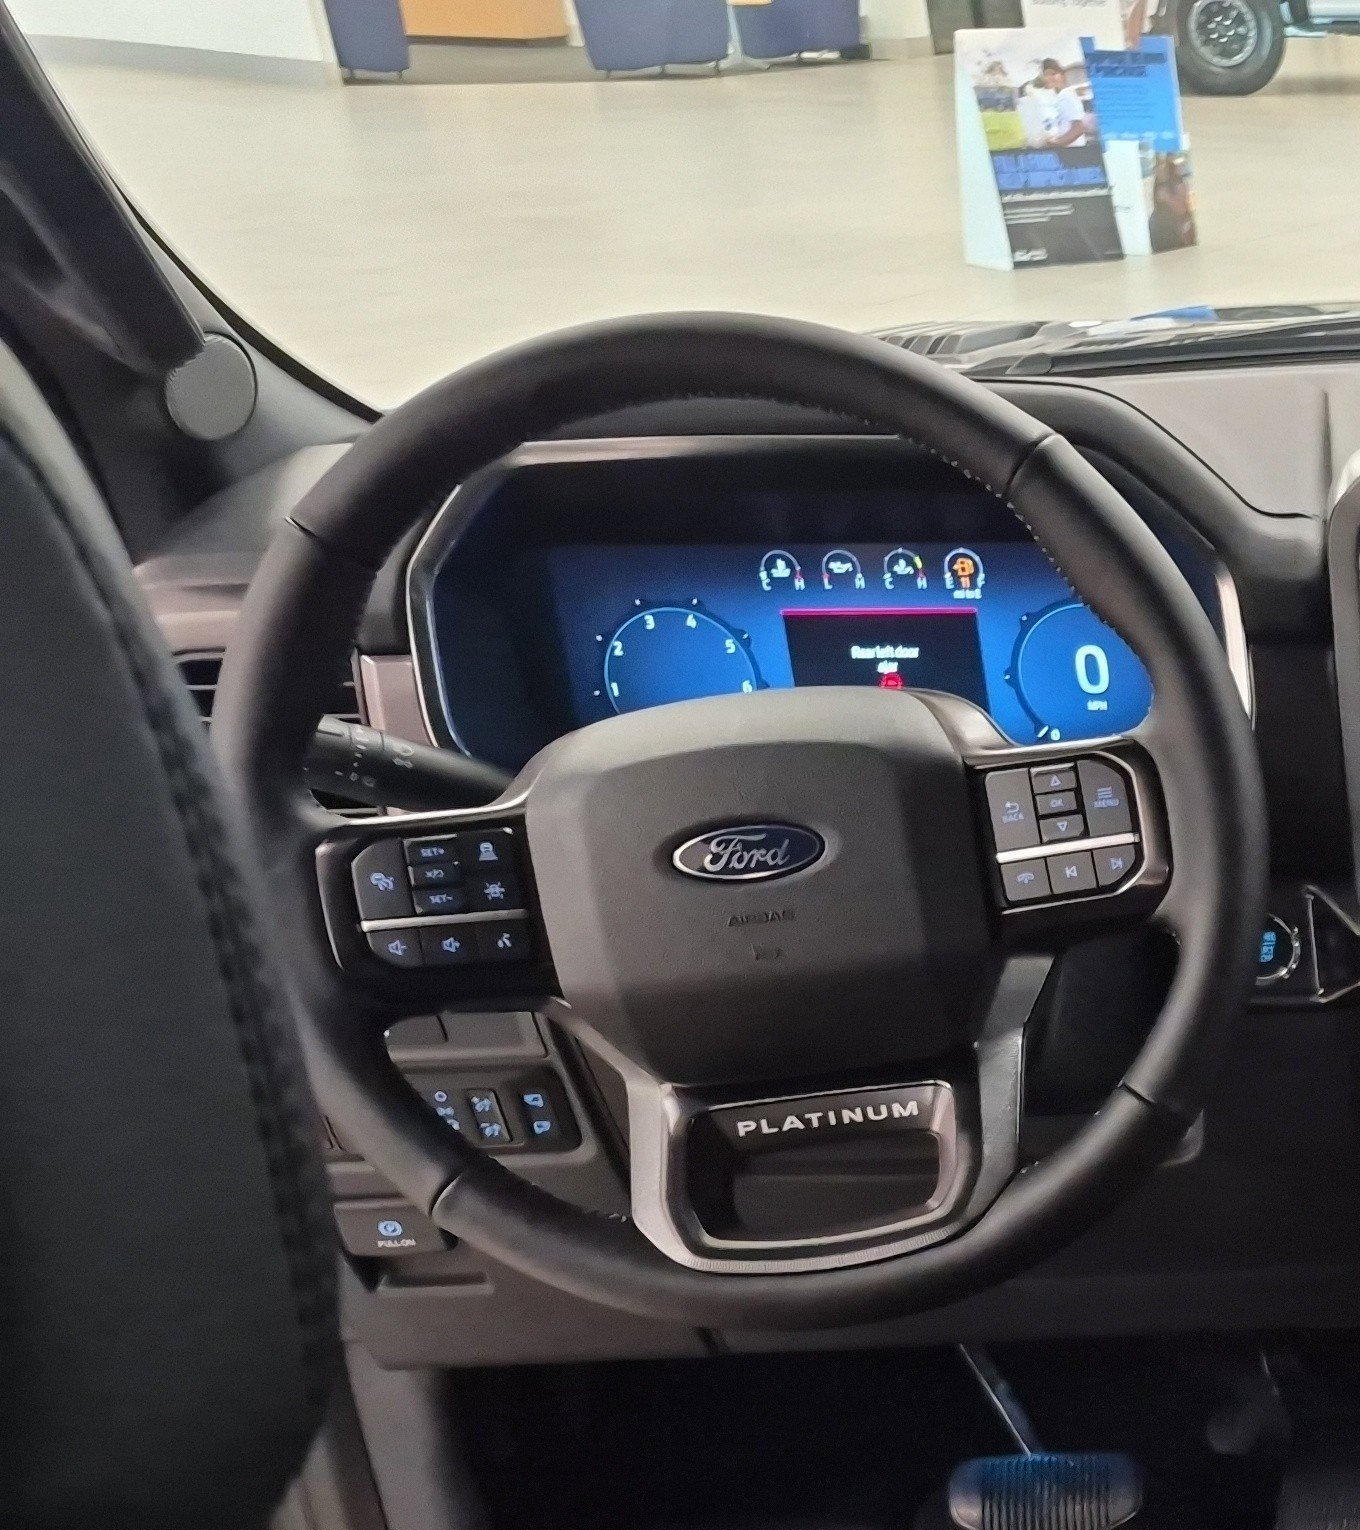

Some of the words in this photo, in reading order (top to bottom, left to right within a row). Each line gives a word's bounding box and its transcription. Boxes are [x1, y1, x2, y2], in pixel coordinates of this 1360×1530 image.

[644, 614, 655, 630] 3
[685, 613, 697, 629] 4
[613, 640, 624, 657] 2
[725, 638, 736, 654] 5
[1074, 644, 1110, 695] 0
[610, 681, 620, 698] 1
[742, 679, 753, 694] 6
[704, 833, 790, 873] Ford
[736, 1100, 919, 1138] PLATINUM
